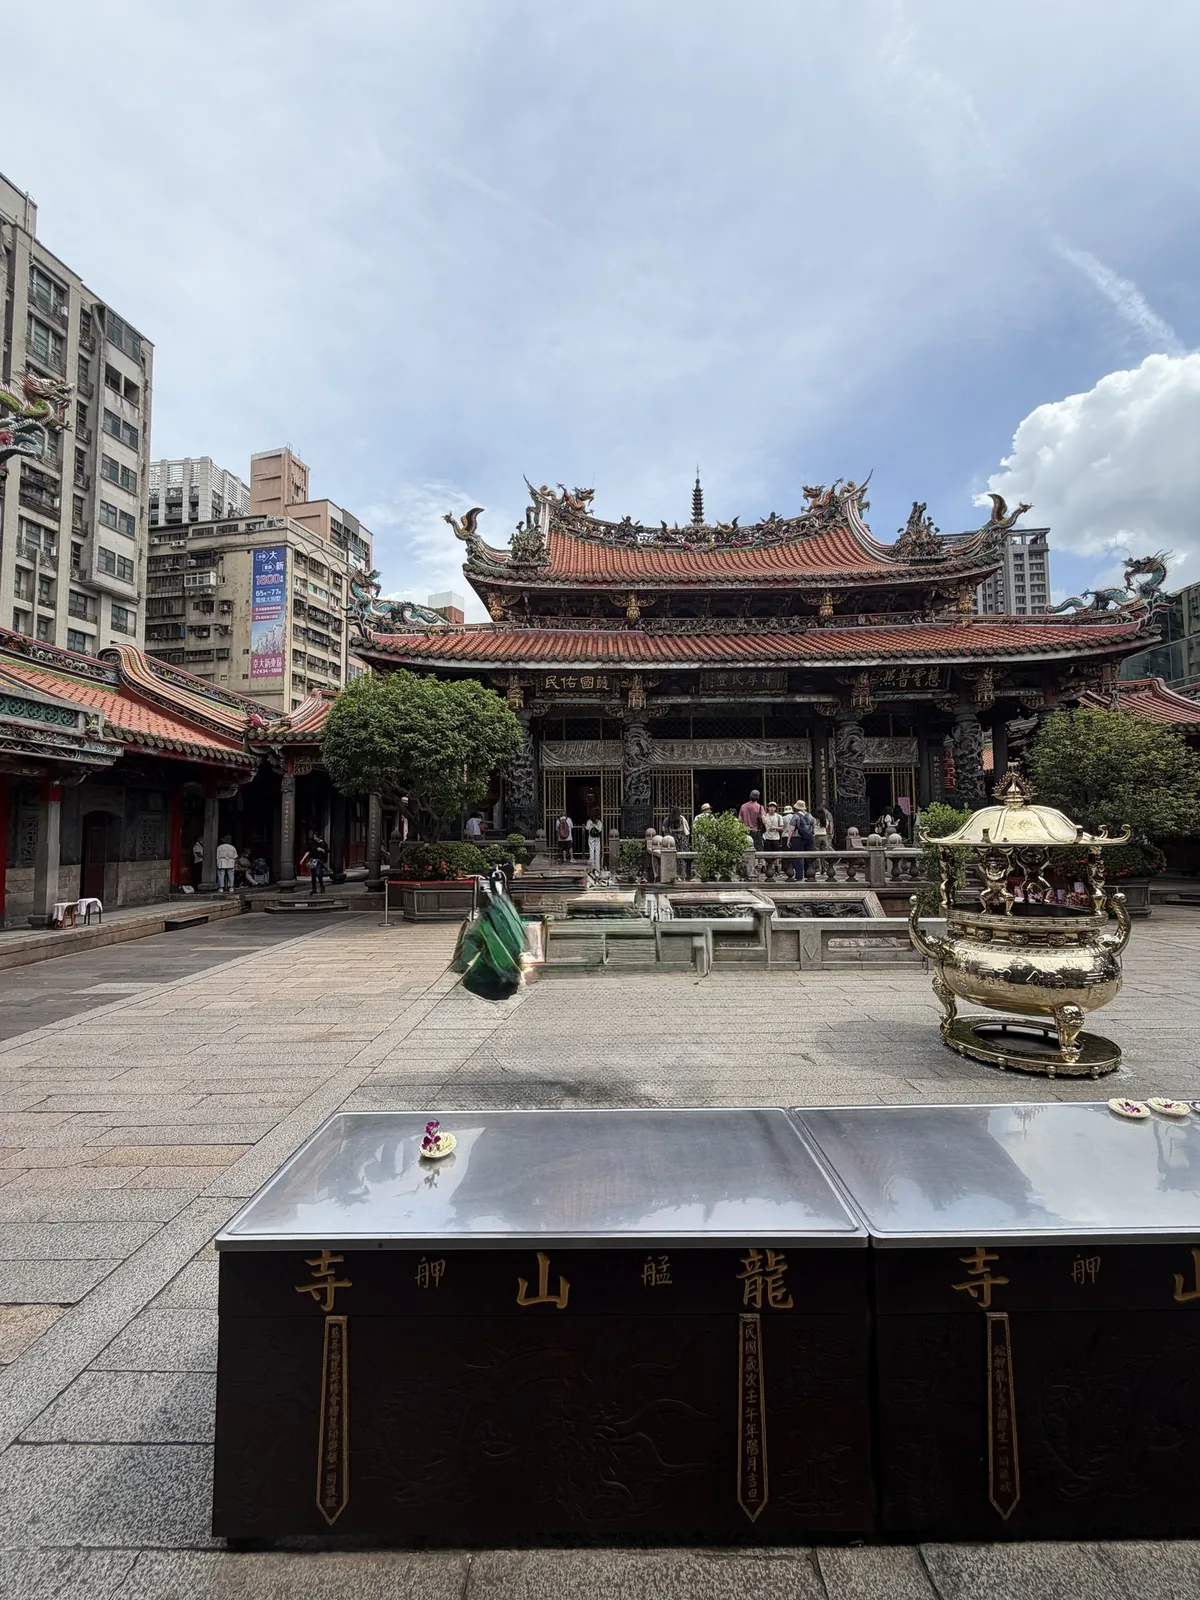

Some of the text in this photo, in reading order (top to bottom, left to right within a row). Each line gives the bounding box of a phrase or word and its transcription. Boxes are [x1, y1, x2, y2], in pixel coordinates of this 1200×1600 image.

[269, 551, 277, 560] 大
[276, 561, 284, 570] 新
[295, 1250, 352, 1311] 寺
[517, 1253, 570, 1309] 山
[736, 1250, 793, 1308] 龍
[951, 1248, 1009, 1308] 寺
